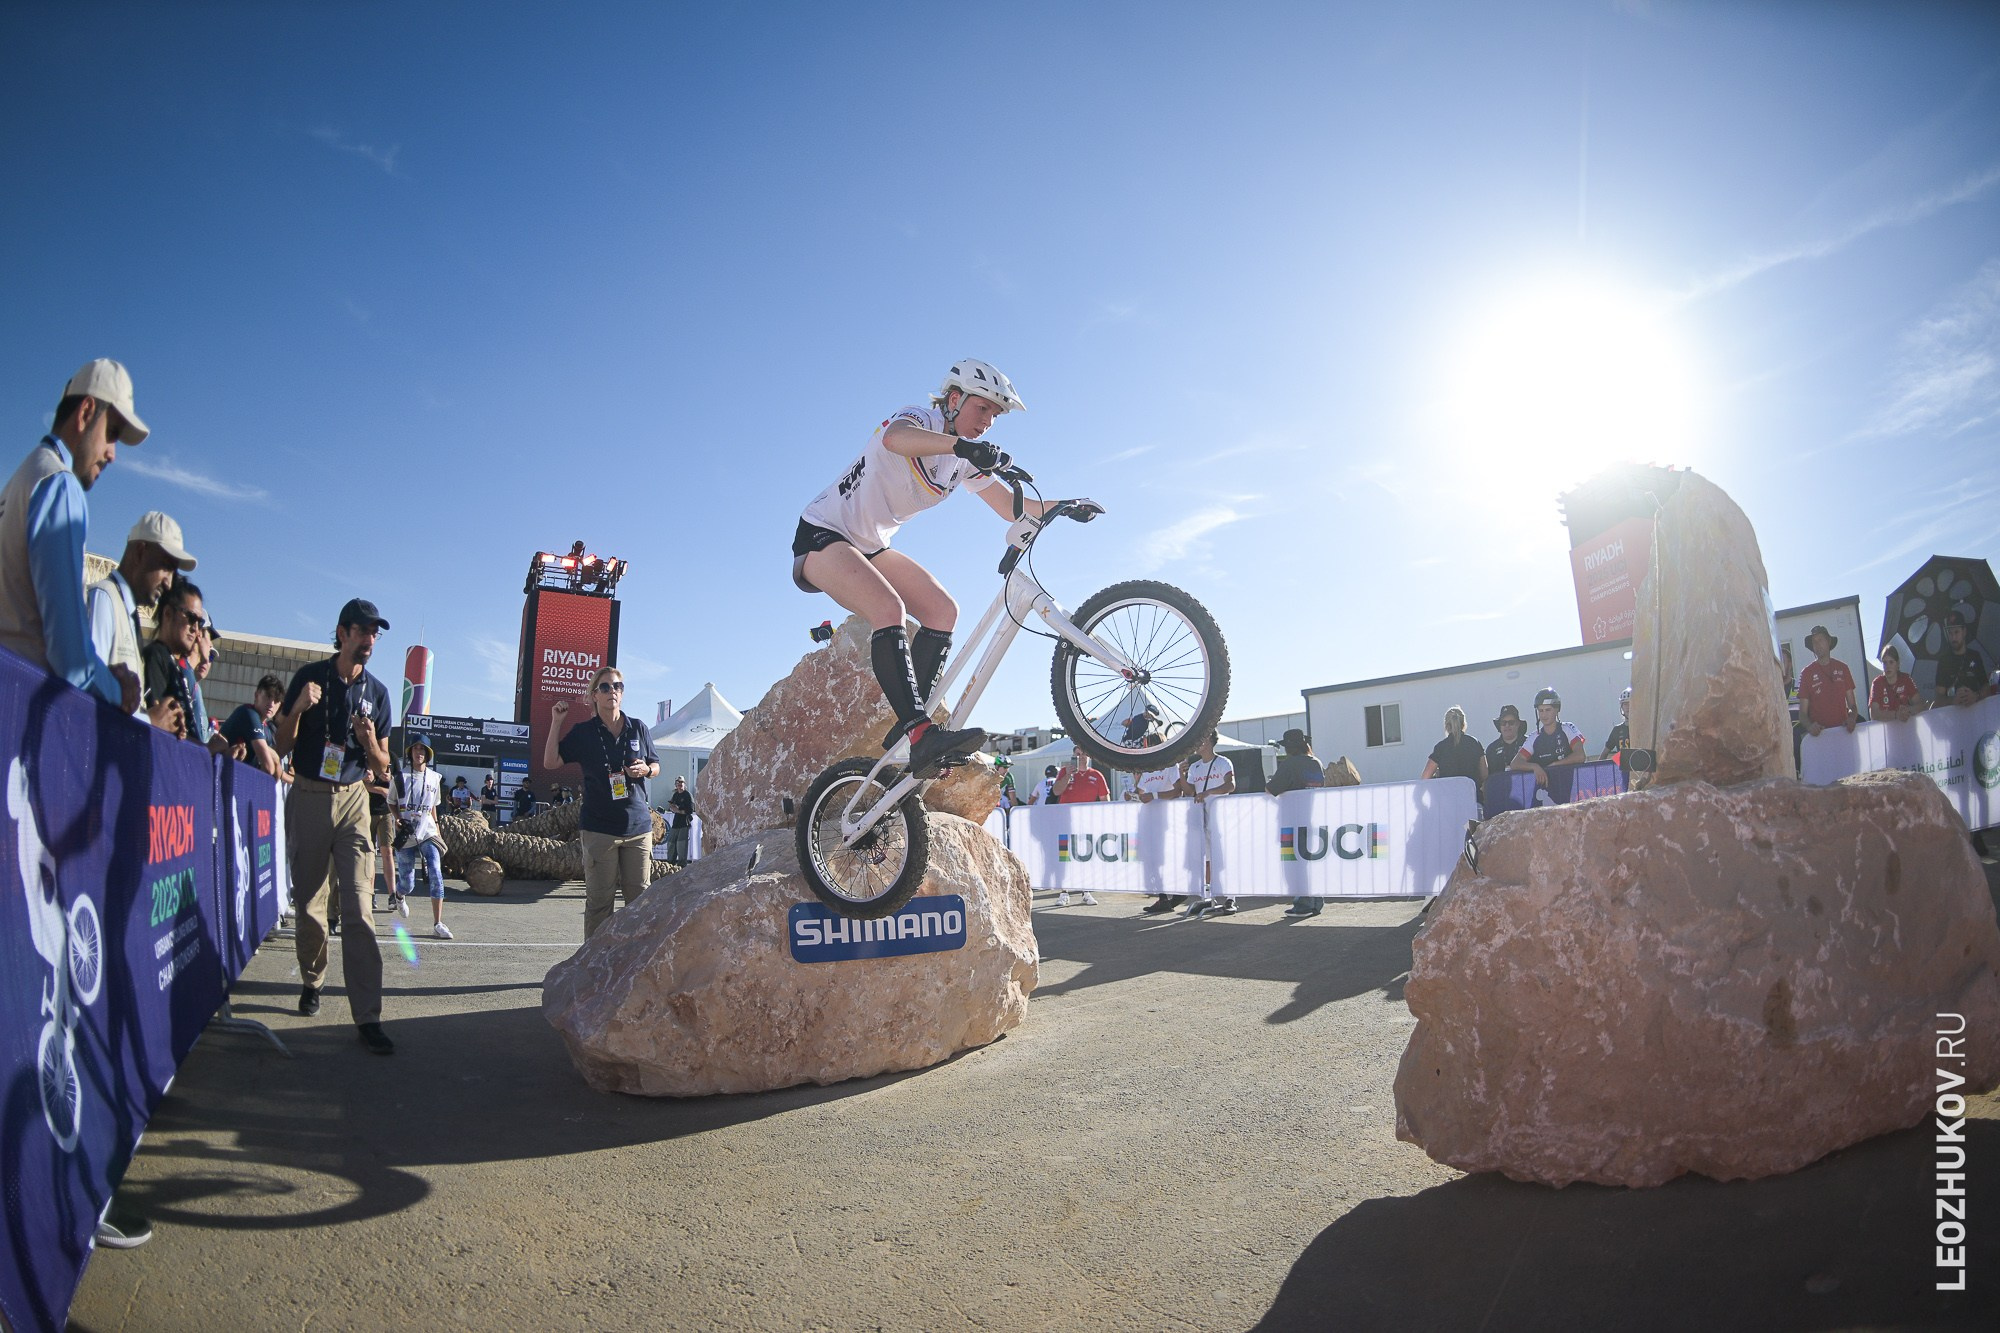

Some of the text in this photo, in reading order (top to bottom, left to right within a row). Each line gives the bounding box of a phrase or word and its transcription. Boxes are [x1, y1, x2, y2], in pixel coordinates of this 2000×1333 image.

[1584, 538, 1624, 571] RIYADH
[543, 649, 600, 668] RIYADH
[542, 665, 595, 681] 2025 UC
[541, 685, 588, 695] CHAMPIONSH
[411, 716, 431, 727] UCI
[454, 743, 481, 753] START
[1144, 775, 1164, 784] JAPAN
[1194, 774, 1219, 783] JAPAN
[1937, 775, 1965, 787] CIPALITY
[149, 805, 194, 864] RIYADH
[1298, 823, 1377, 860] UCI
[1071, 833, 1128, 862] UCI
[151, 874, 180, 927] 2025
[795, 910, 962, 946] SHIMANO
